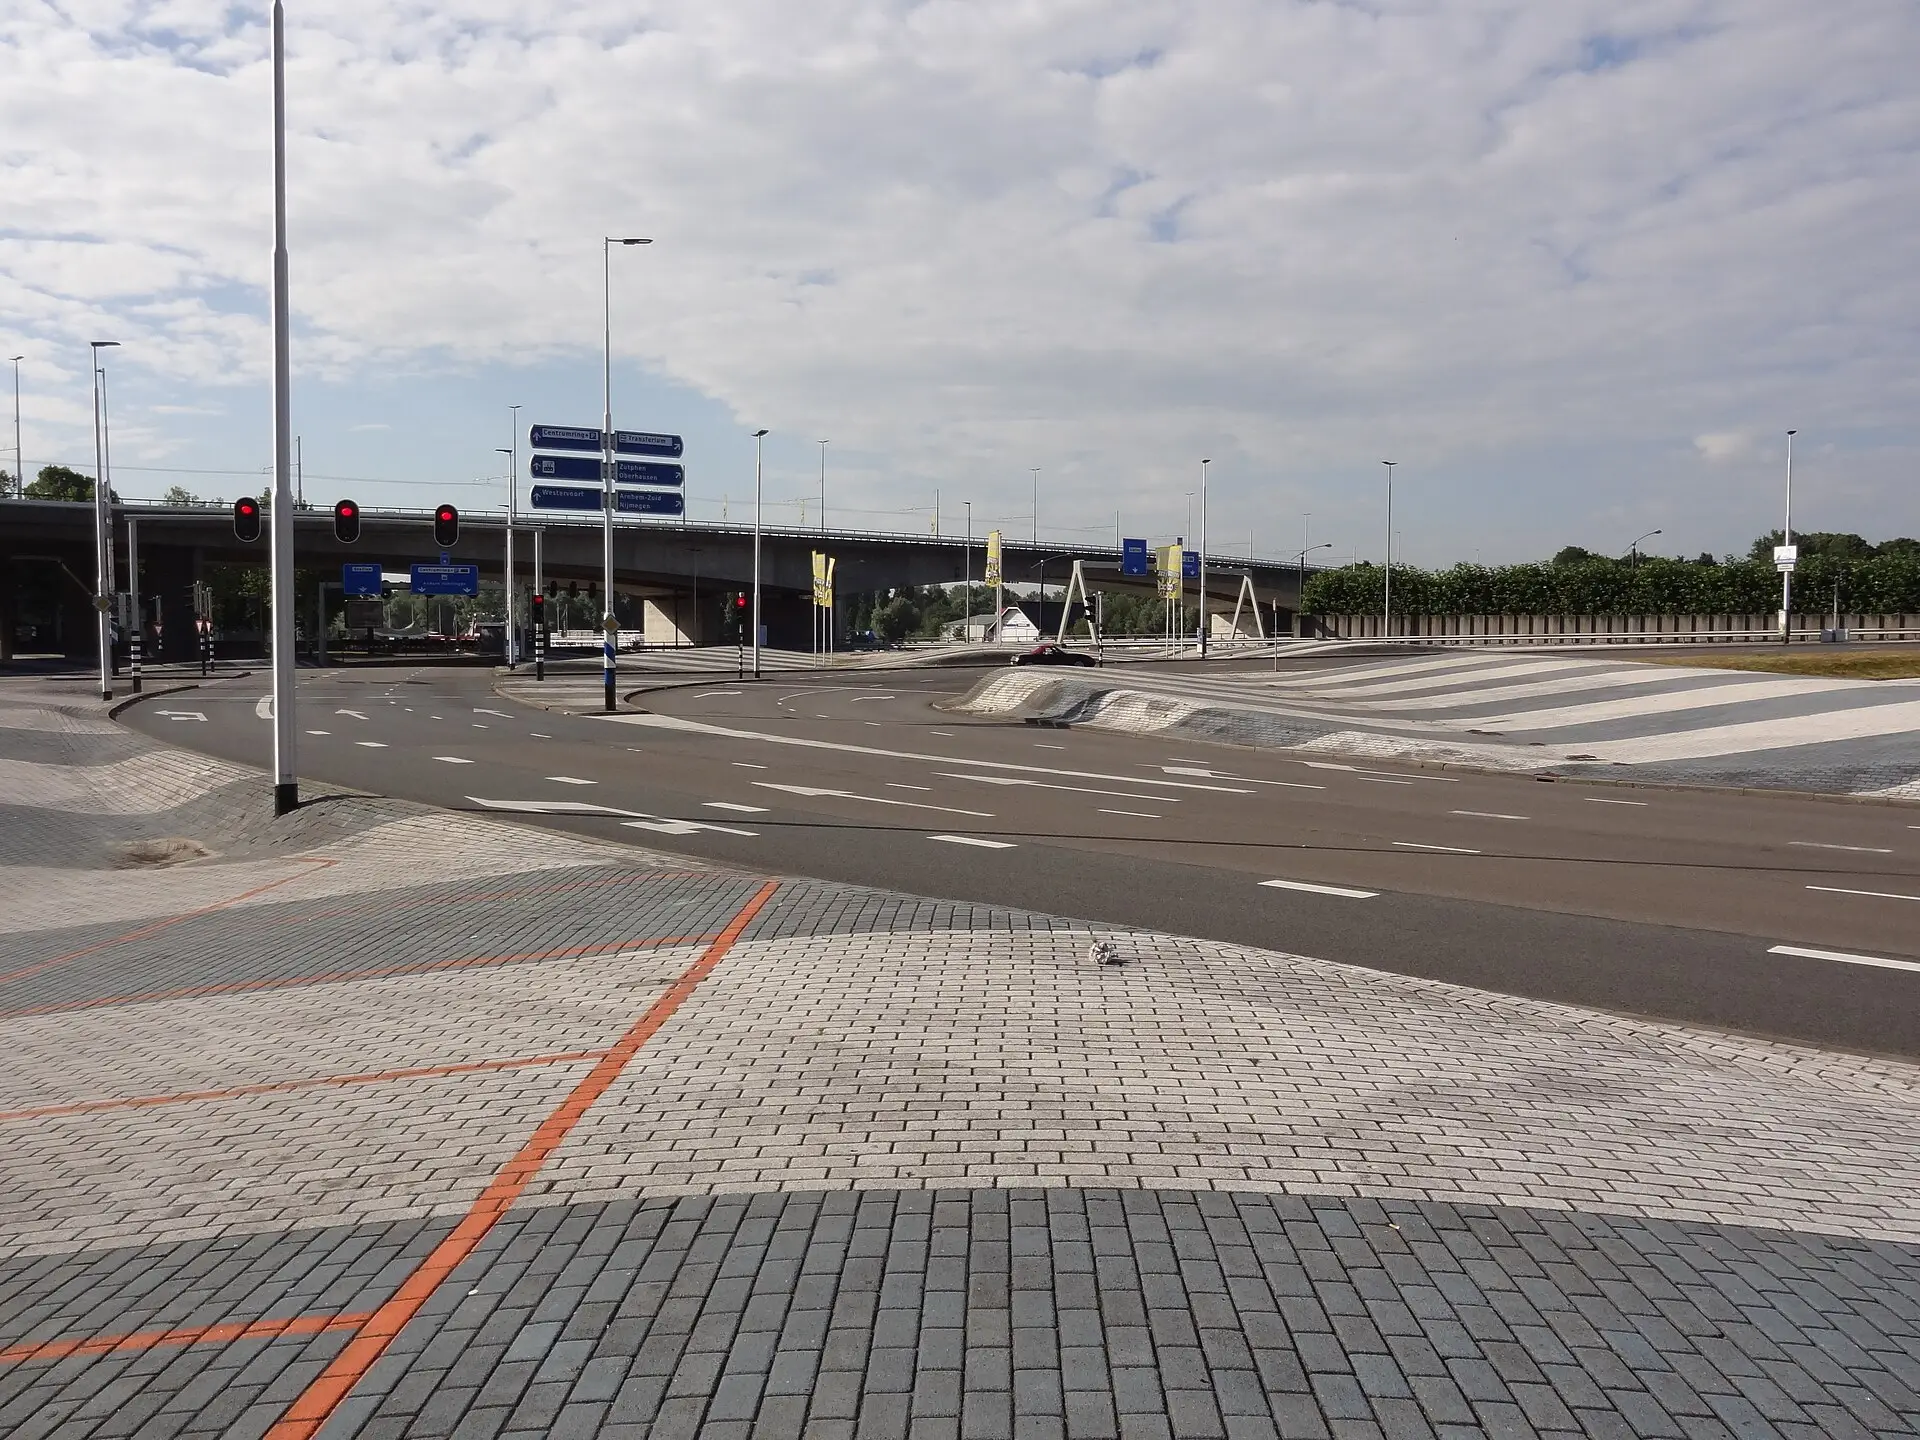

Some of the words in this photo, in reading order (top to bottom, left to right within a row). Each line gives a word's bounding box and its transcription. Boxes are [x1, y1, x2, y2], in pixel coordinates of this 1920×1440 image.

[619, 463, 647, 472] Zutphen
[619, 472, 658, 481] Oberhausen
[542, 488, 585, 497] Westervoort
[619, 493, 662, 502] Arnhem-Zuid
[619, 501, 651, 510] Nijmegen
